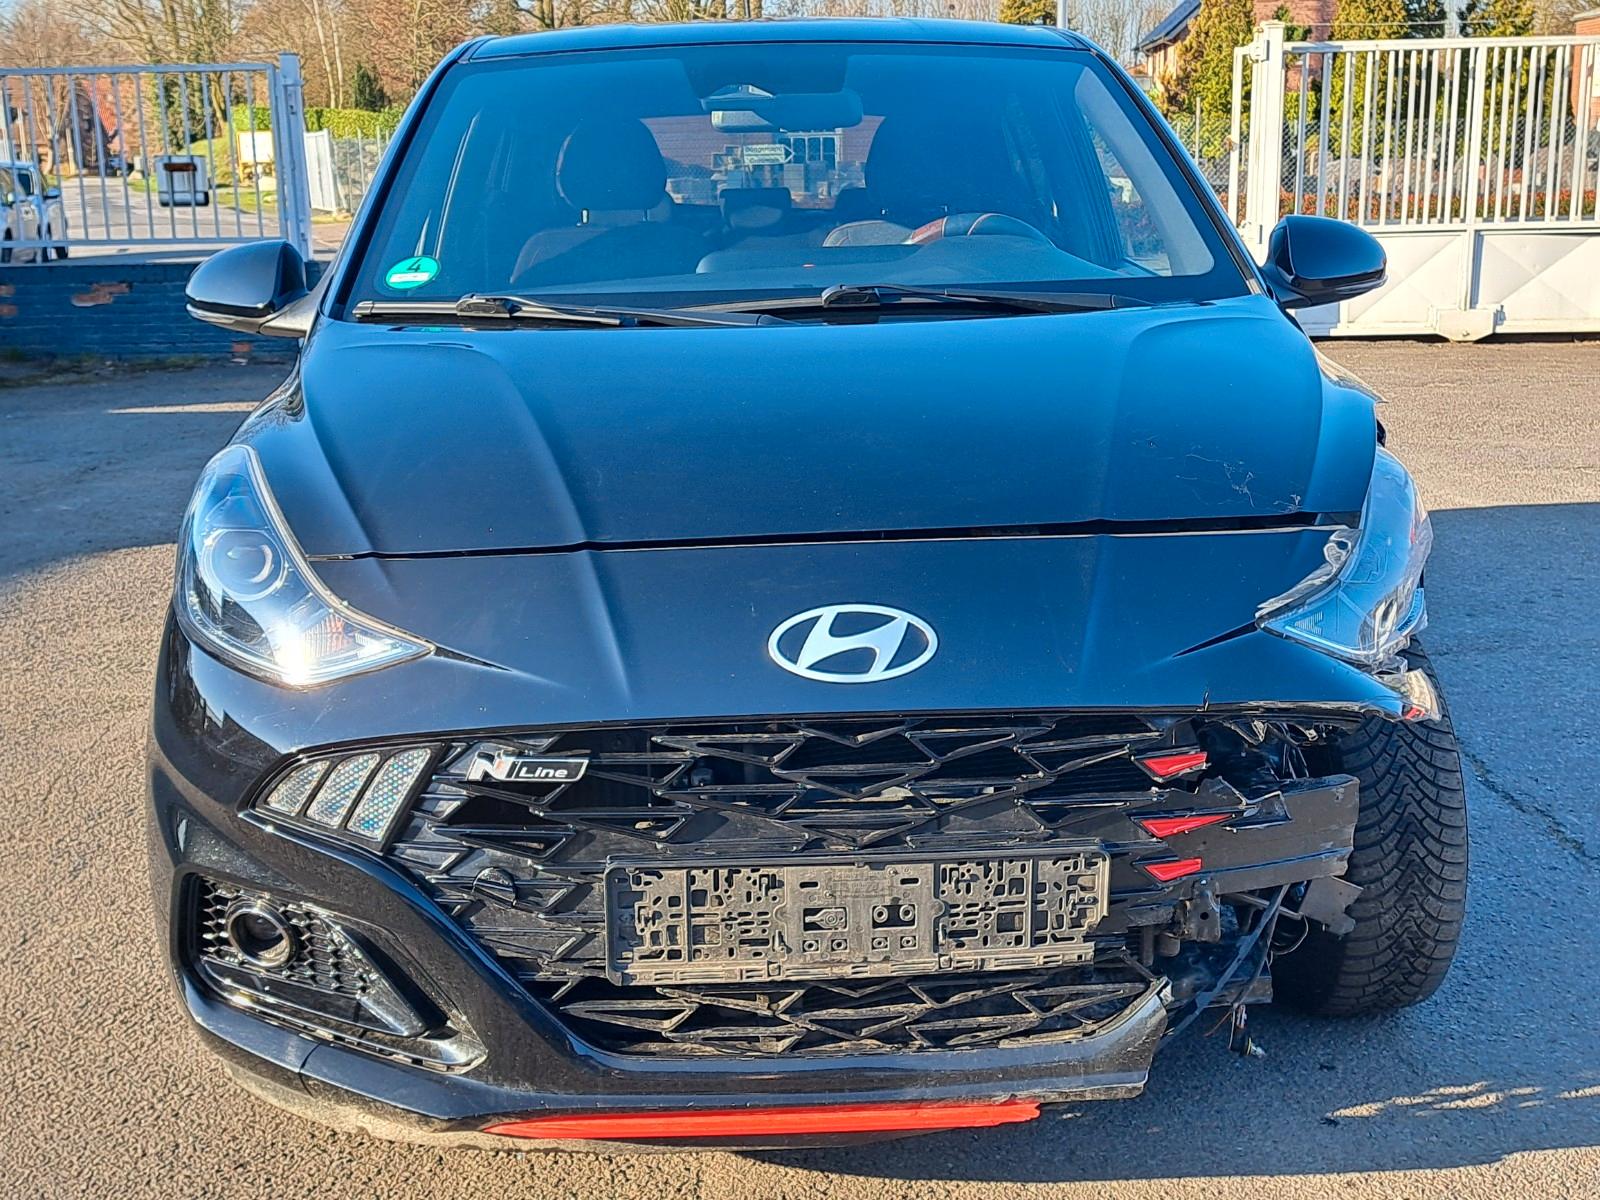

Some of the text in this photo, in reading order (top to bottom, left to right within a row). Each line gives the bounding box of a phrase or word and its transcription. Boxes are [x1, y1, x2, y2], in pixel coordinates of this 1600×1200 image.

[406, 257, 422, 273] 4
[466, 751, 568, 781] N Line
